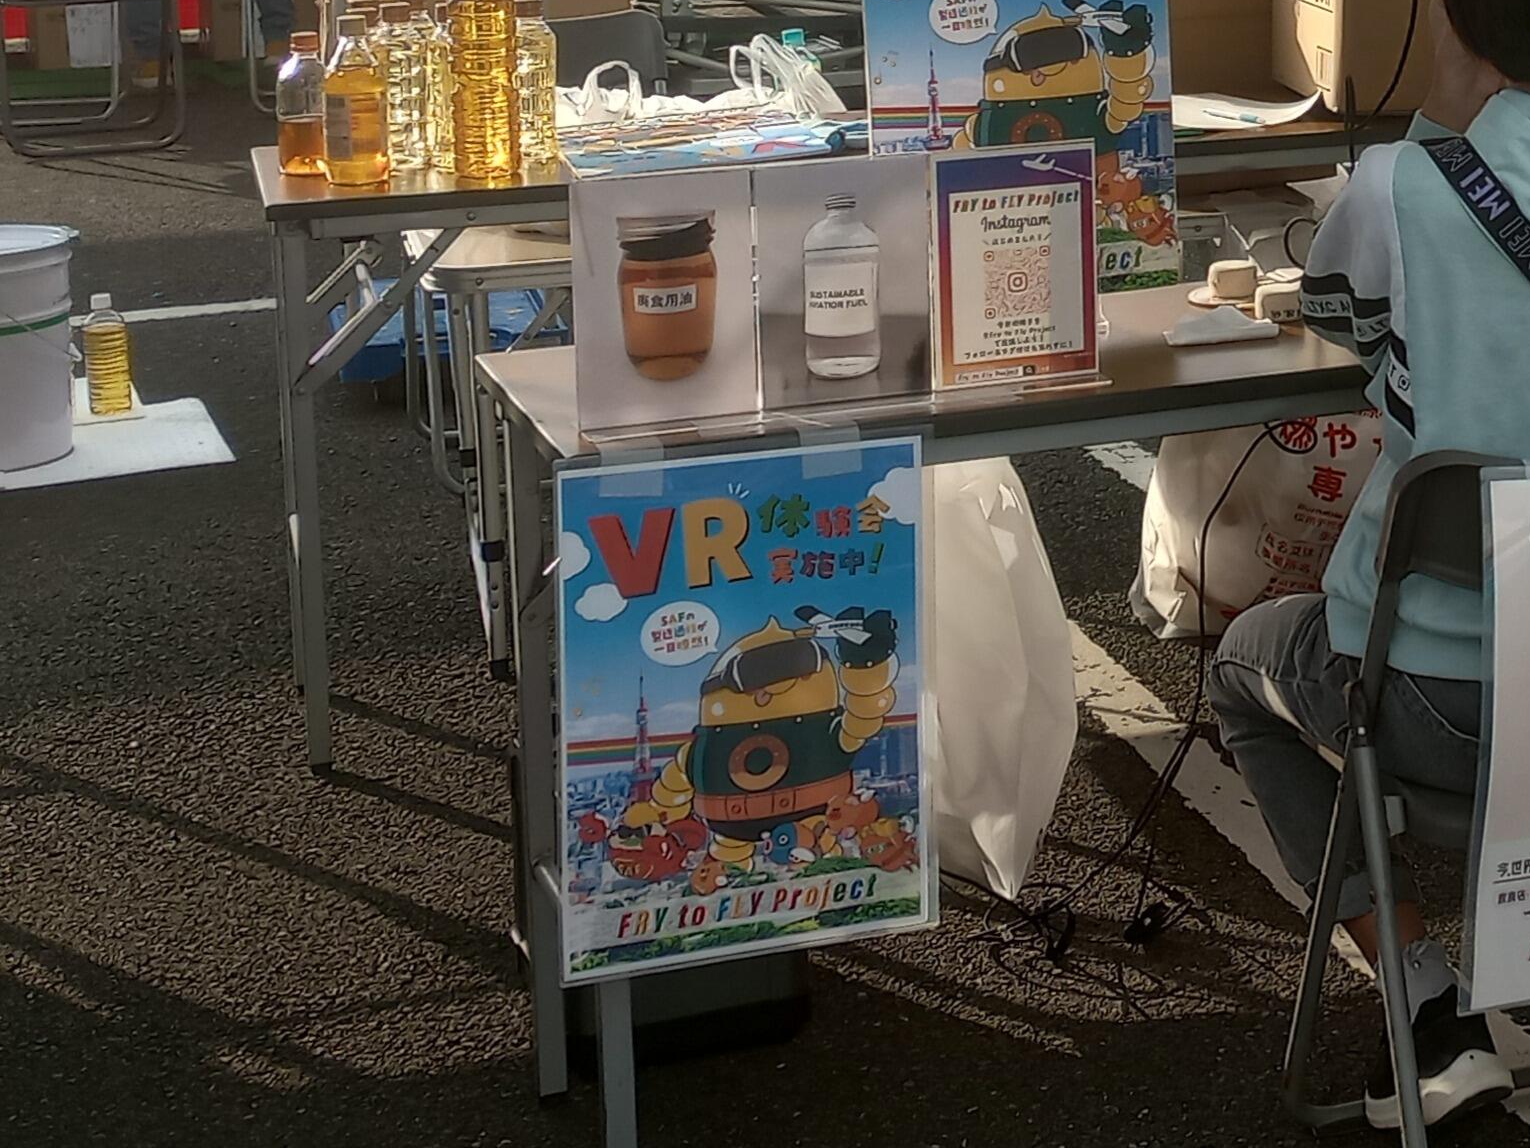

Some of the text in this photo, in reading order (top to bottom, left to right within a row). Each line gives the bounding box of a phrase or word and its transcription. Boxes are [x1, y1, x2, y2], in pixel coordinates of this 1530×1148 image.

[980, 214, 1051, 233] Instagram
[586, 493, 890, 599] VR 体験会
[617, 872, 880, 939] FRY to FLY Project
